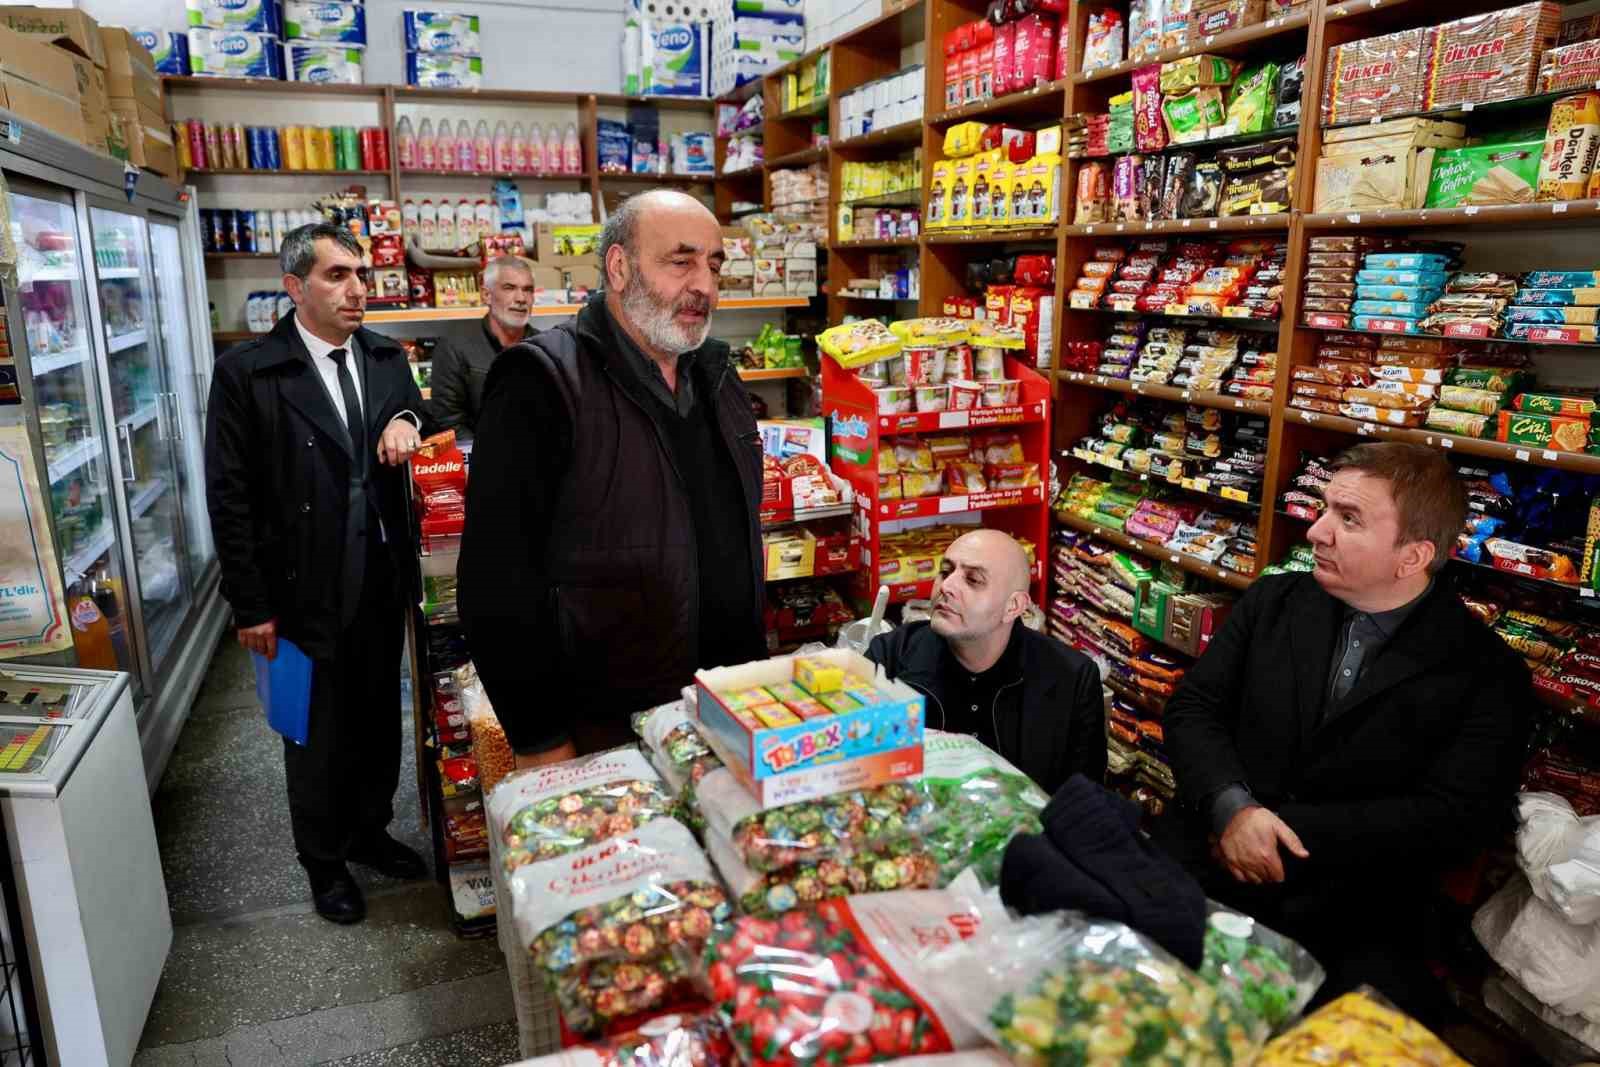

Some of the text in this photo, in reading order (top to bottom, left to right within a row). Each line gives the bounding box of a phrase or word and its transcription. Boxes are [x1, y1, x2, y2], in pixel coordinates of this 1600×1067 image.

[1444, 39, 1505, 64] ÜLKER
[1343, 62, 1393, 82] ÜLKER
[1558, 128, 1585, 180] Dankek
[414, 462, 462, 475] tadelle
